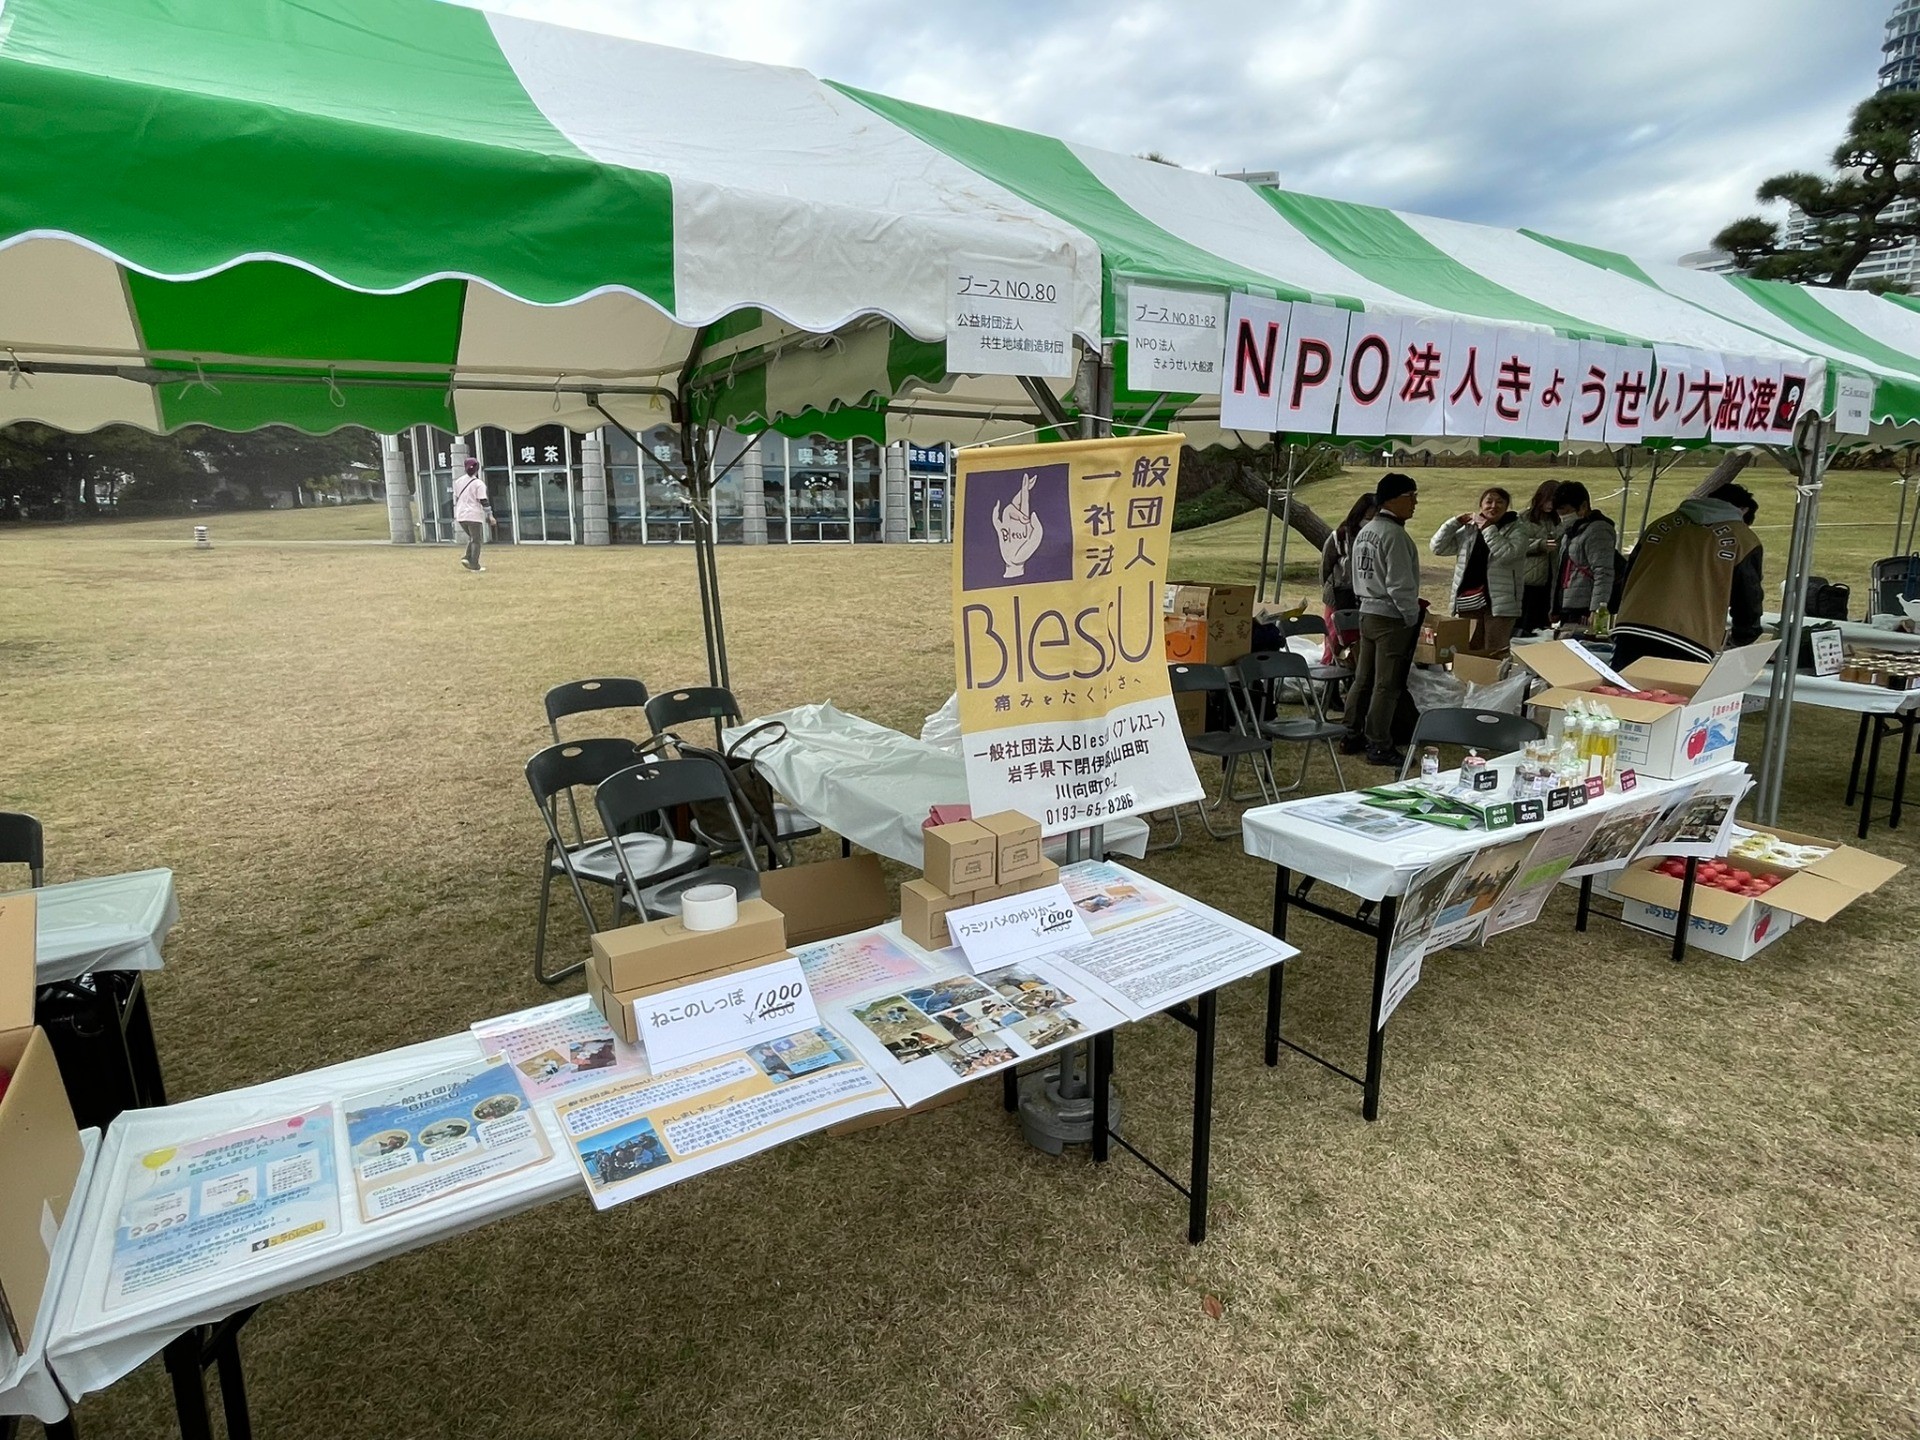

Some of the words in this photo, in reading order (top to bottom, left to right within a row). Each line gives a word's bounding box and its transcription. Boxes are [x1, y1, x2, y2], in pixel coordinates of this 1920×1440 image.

[957, 275, 1002, 296] ブース
[1005, 281, 1057, 302] NO.80
[957, 313, 1024, 331] 公益財団法人
[1135, 305, 1169, 322] ブース
[980, 336, 1065, 354] 共生地域創造財団
[1153, 357, 1215, 374] きょうせい大船渡
[520, 445, 559, 463] 喫茶
[1046, 792, 1134, 825] 0193-65-8286
[650, 988, 746, 1028] ねこのしっぽ
